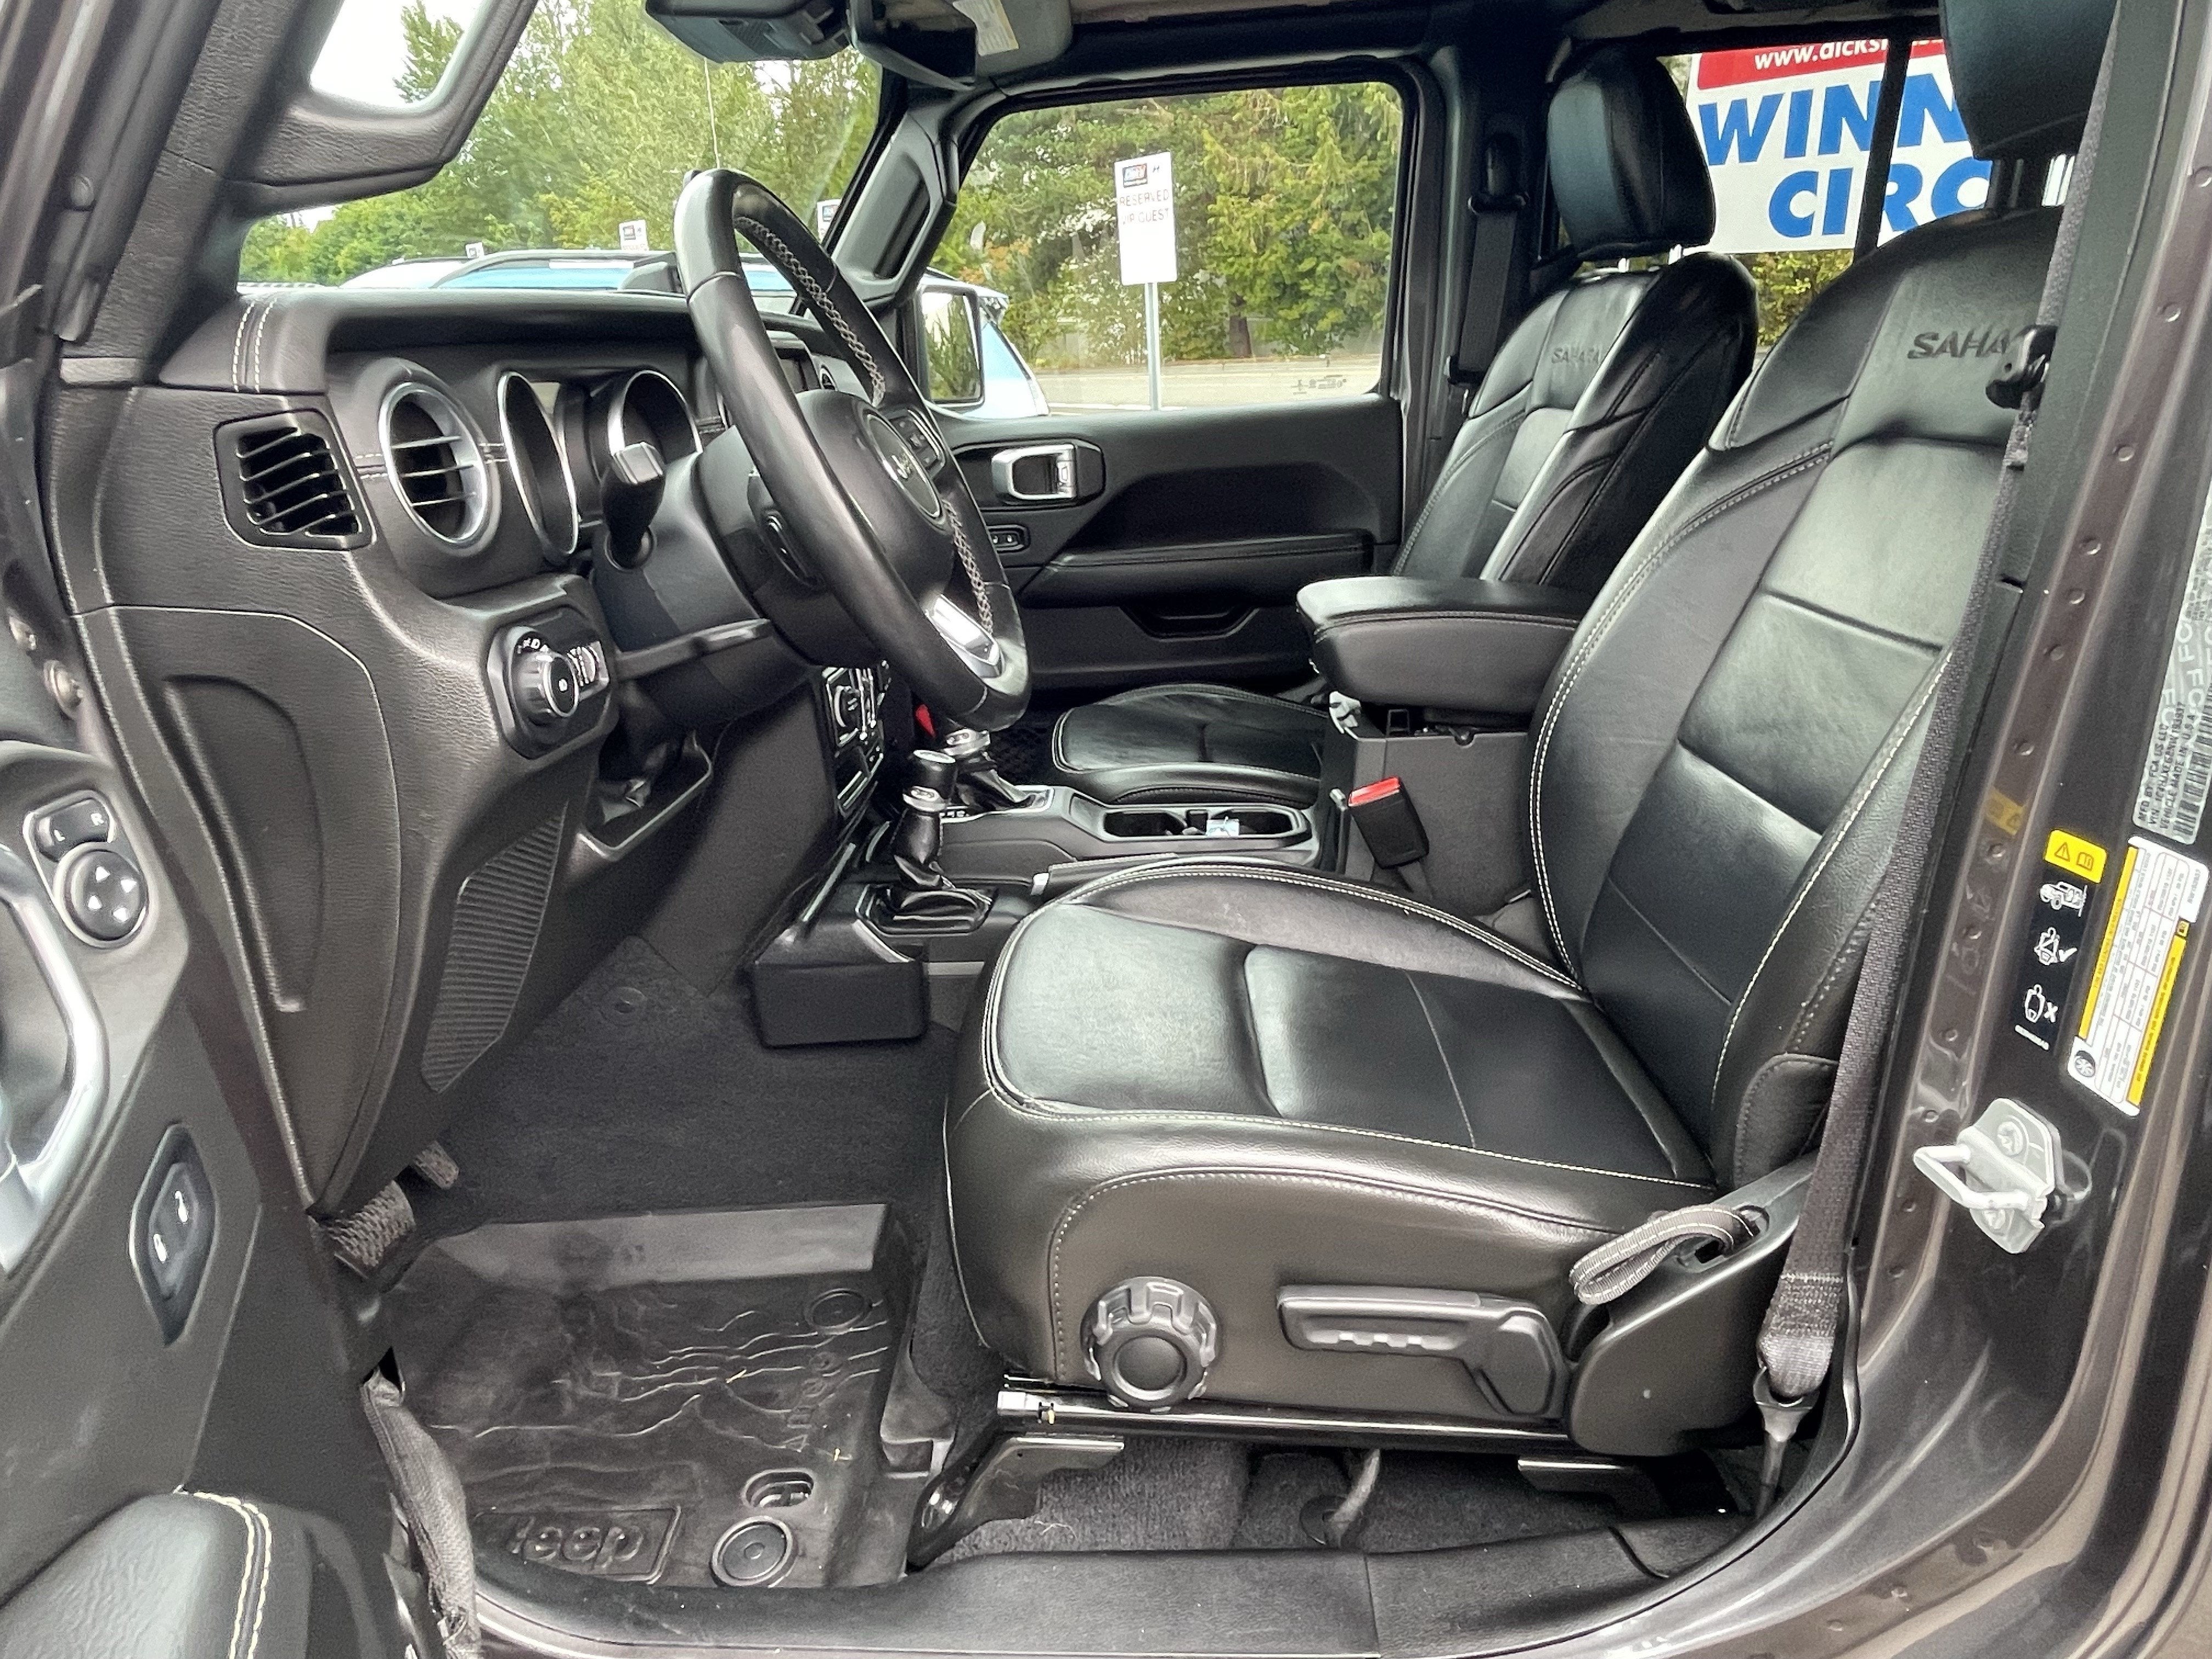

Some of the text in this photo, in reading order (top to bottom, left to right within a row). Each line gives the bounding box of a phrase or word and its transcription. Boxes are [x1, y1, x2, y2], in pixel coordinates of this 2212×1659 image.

[1120, 189, 1170, 207] RESERVED
[1138, 208, 1170, 223] GUEST
[90, 813, 104, 826] R
[54, 830, 66, 842] L
